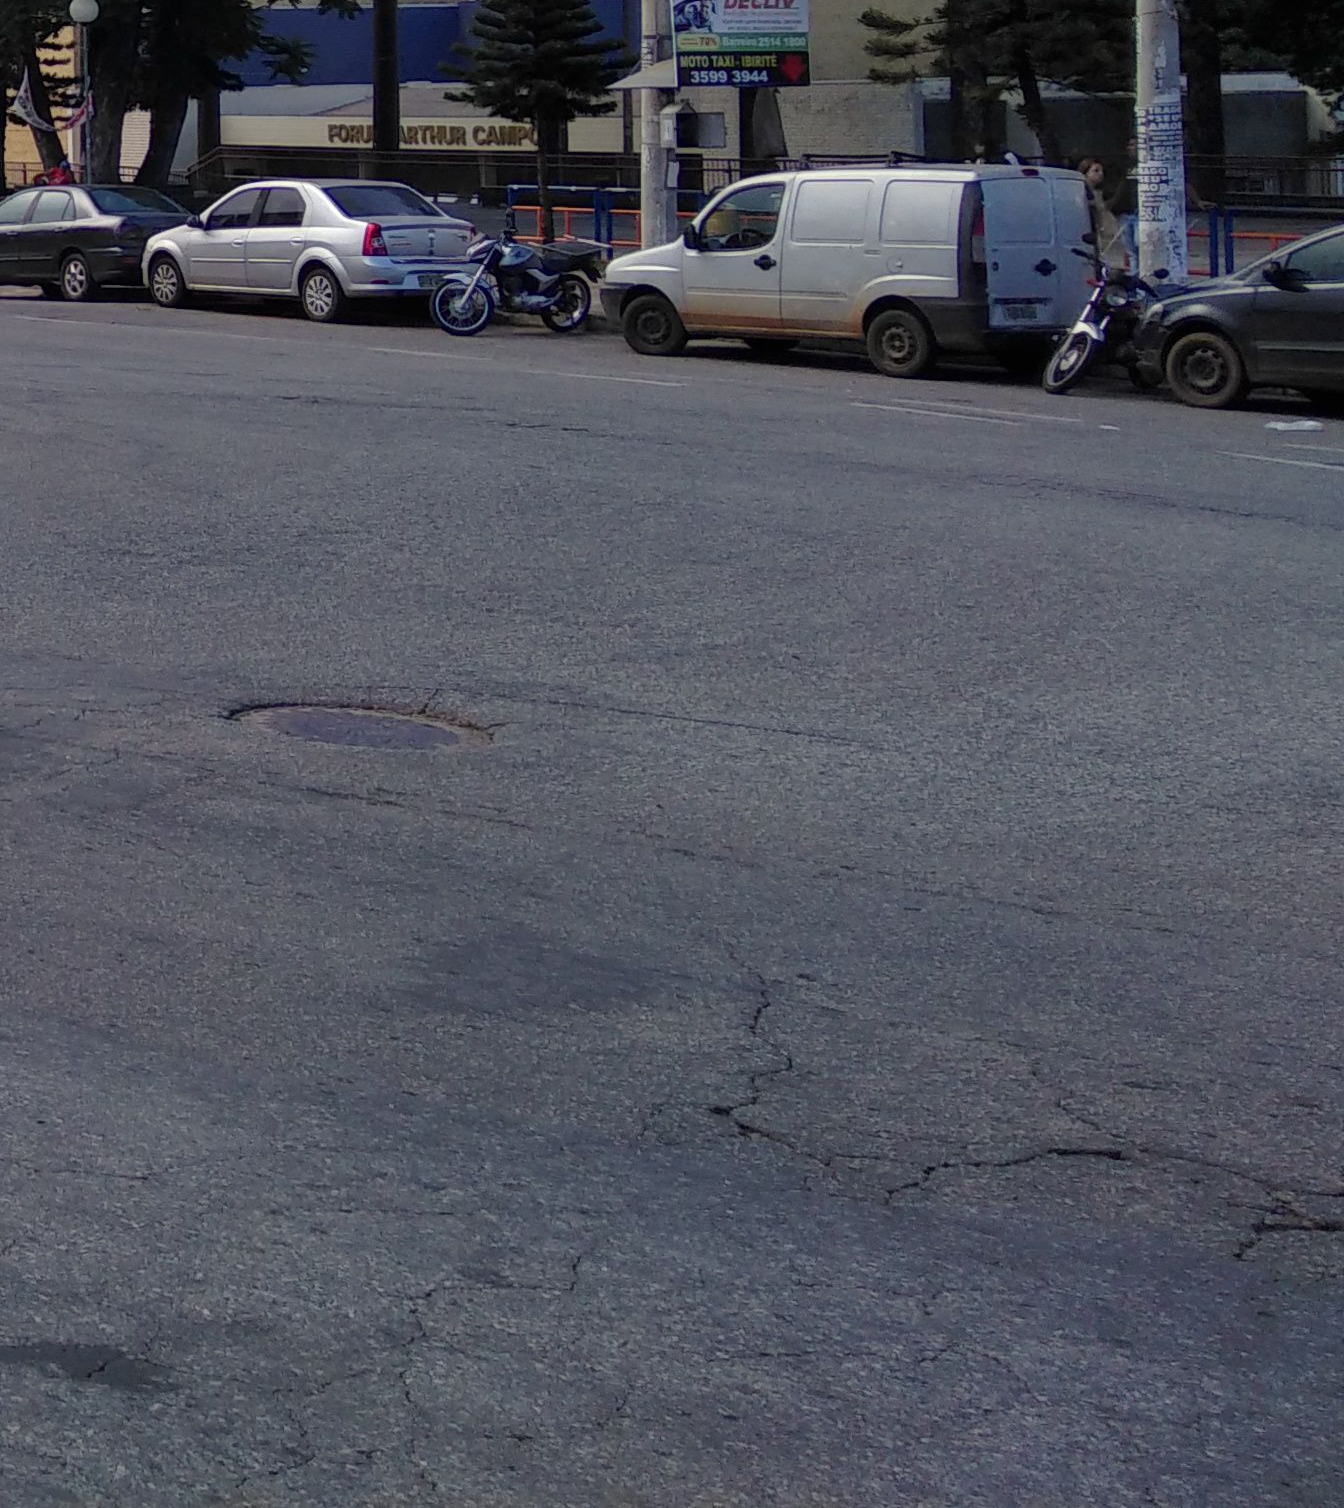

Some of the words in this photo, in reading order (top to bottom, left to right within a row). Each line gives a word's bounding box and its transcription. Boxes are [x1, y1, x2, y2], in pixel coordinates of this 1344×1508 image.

[757, 36, 781, 47] 2514
[680, 55, 709, 68] MOTO
[712, 54, 735, 67] TAXI
[741, 52, 778, 67] IBIRITÉ
[690, 71, 728, 83] 3599
[732, 70, 769, 82] 3944
[328, 124, 373, 143] FORU
